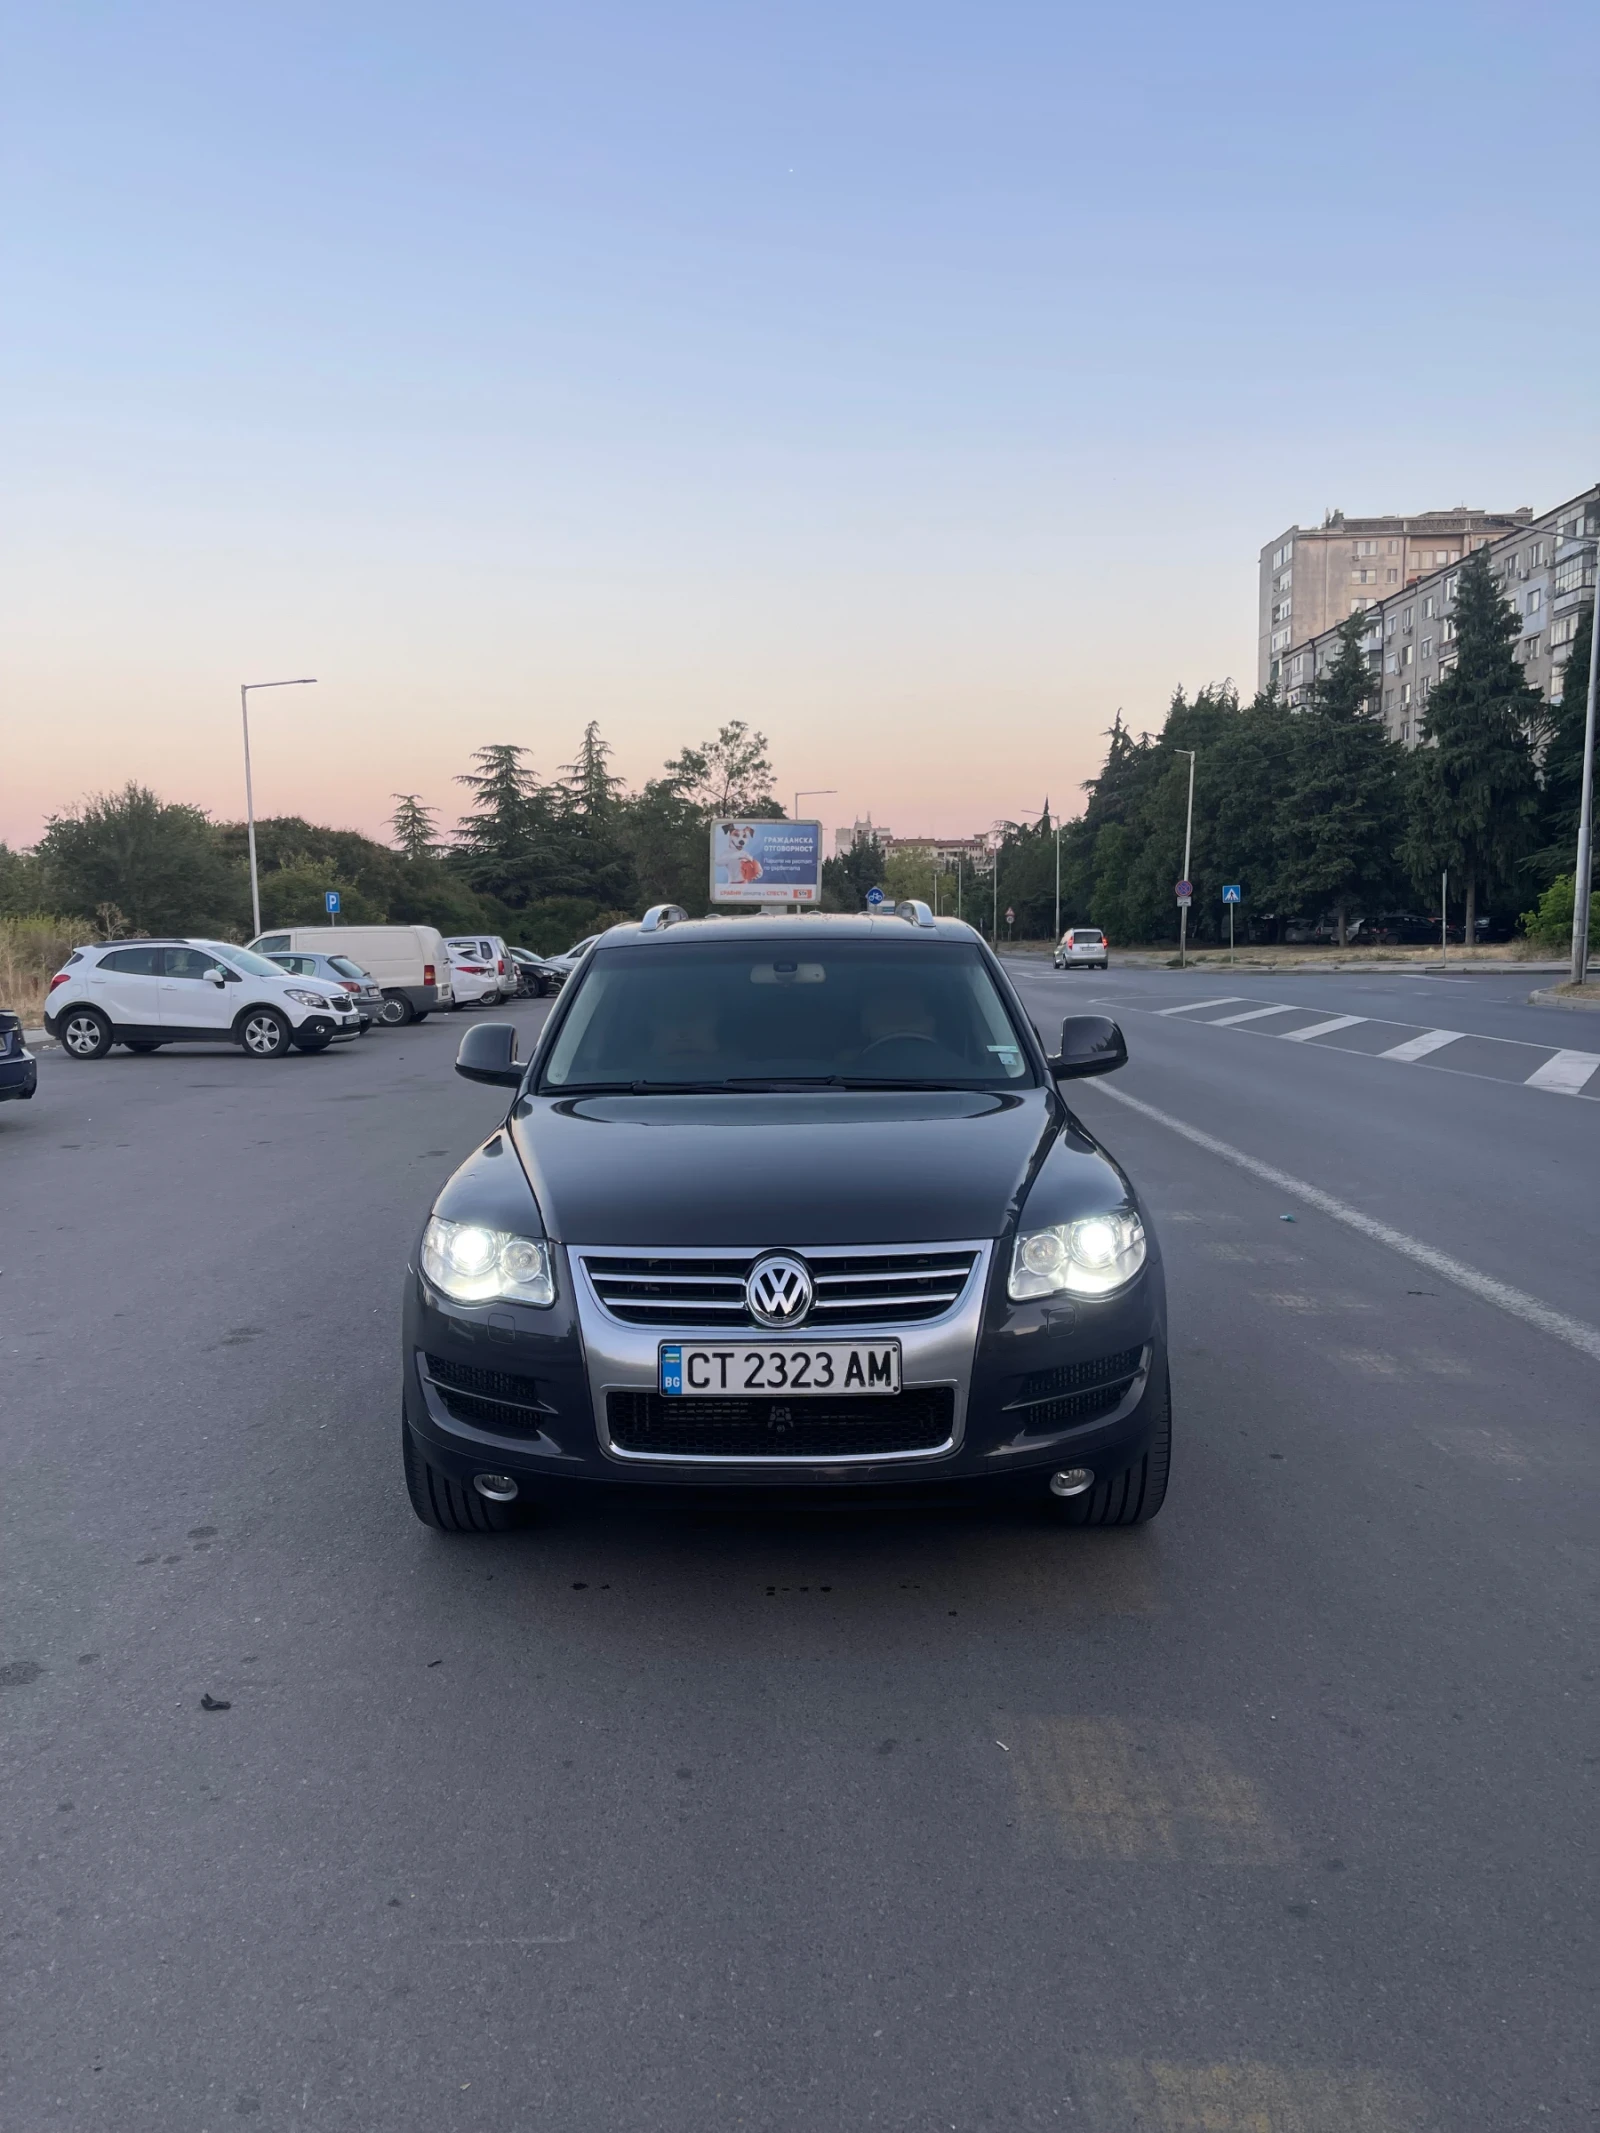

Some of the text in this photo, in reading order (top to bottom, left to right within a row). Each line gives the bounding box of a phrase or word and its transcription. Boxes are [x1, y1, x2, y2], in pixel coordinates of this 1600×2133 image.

[763, 836, 813, 844] ГРАЖДАНСКА
[329, 895, 336, 909] P
[750, 1262, 809, 1320] VW
[687, 1350, 892, 1389] CT 2323 AM
[665, 1376, 680, 1388] BG
